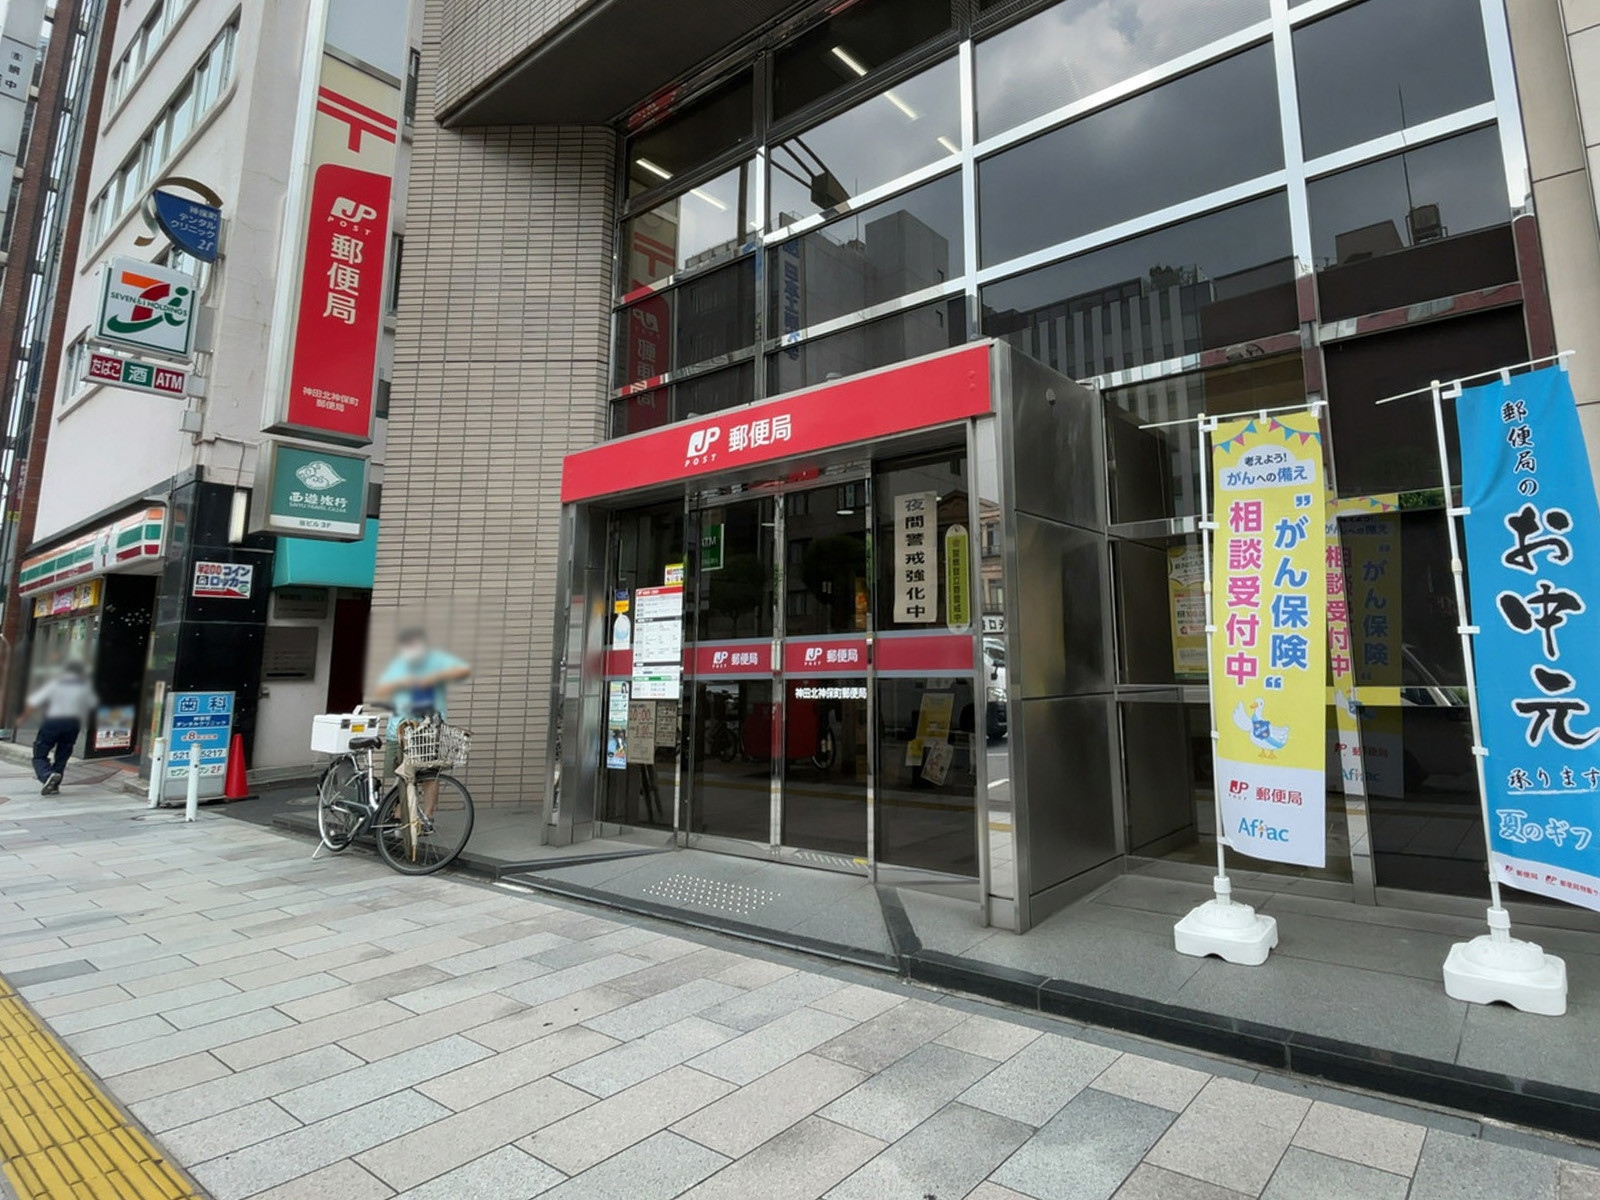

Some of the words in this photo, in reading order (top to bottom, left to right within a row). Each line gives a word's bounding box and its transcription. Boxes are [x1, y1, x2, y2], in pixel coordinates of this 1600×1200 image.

[170, 220, 215, 239] クリニック
[179, 213, 216, 230] デンタル
[327, 216, 373, 236] POST
[323, 233, 364, 325] 郵便局
[147, 302, 188, 317] HOLDINGS
[91, 358, 121, 377] たばこ
[128, 364, 148, 383] 酒
[155, 372, 183, 390] ATM
[302, 386, 360, 407] 神田北神保町
[316, 399, 345, 412] 郵便局
[728, 414, 792, 453] 郵便局
[1501, 399, 1539, 497] 郵便局の
[684, 453, 718, 468] POST
[1244, 452, 1288, 467] 考えよう!
[1226, 465, 1308, 487] がんへの備え
[288, 491, 348, 509] 西遊旅行
[904, 499, 926, 618] 夜間警戒強化中
[209, 576, 249, 587] ロッカー
[223, 566, 251, 578] コイン
[1225, 500, 1263, 686] 相談受付中
[1497, 503, 1600, 749] お中元
[731, 652, 759, 666] 郵便局
[826, 648, 859, 663] 郵便局
[795, 687, 868, 700] 神田北神保町郵便局
[210, 765, 222, 774] 2F
[1508, 765, 1600, 791] 承ります
[1256, 786, 1303, 806] 郵便局
